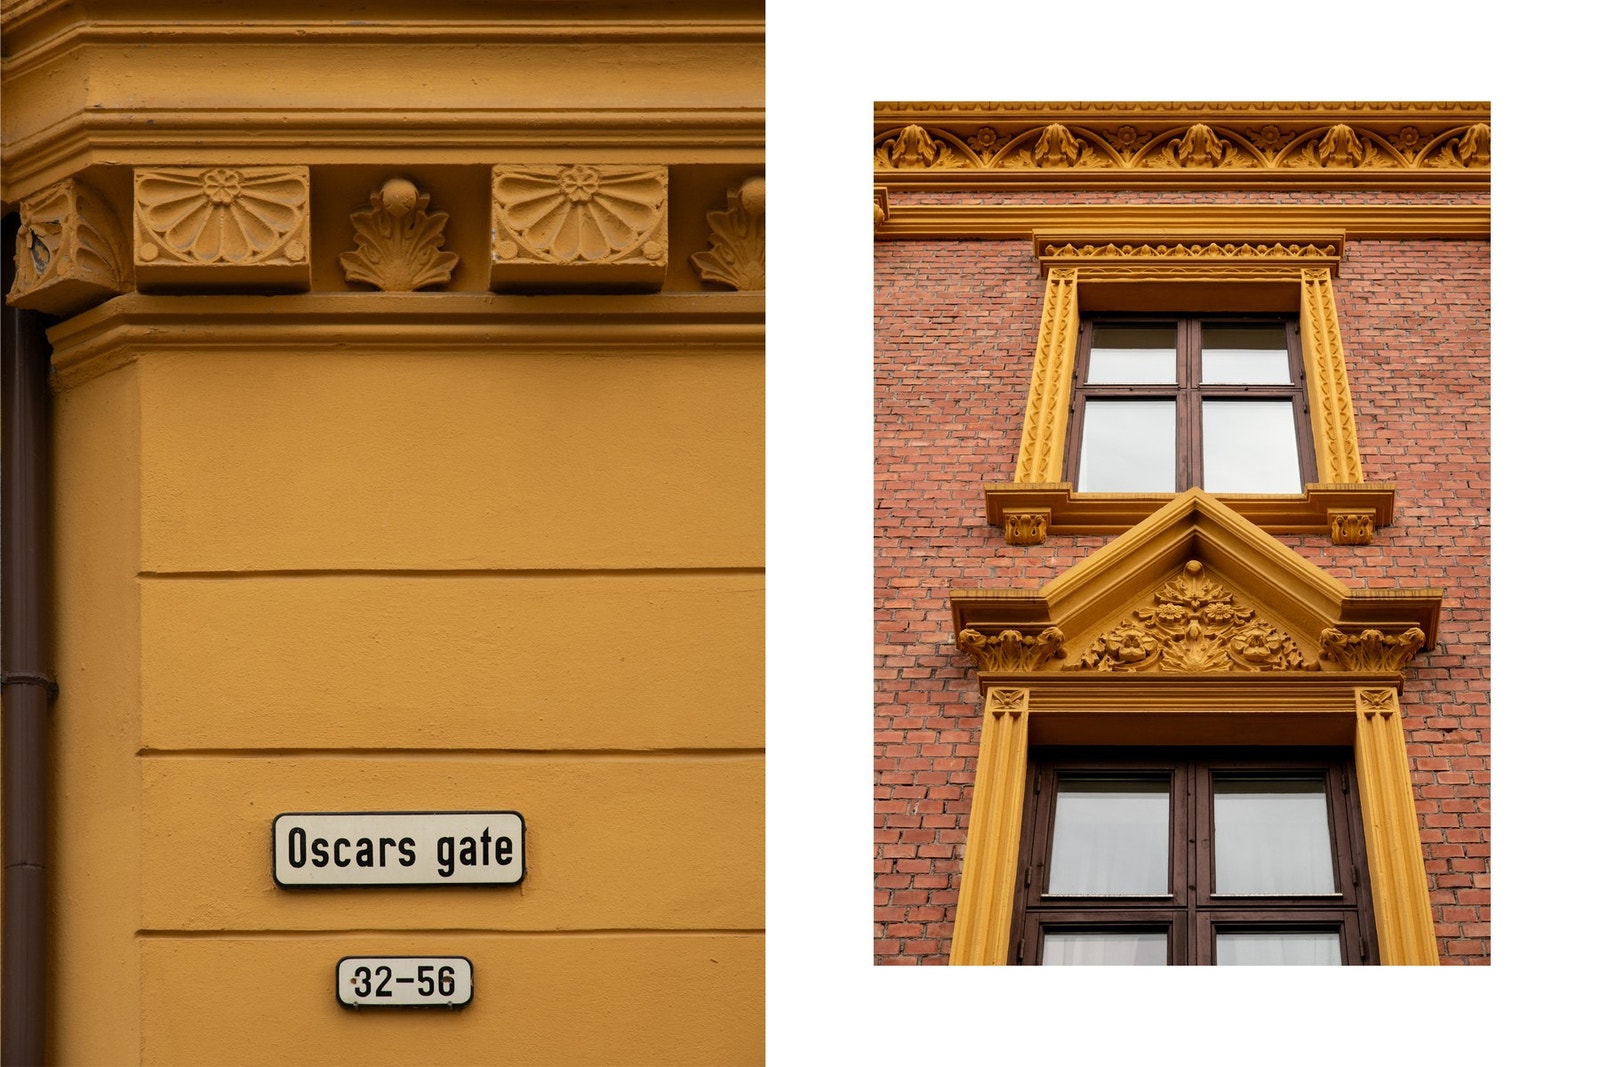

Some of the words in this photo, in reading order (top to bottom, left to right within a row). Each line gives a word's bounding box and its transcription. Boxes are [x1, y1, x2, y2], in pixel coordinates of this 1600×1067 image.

[288, 827, 416, 868] Oscars
[437, 827, 513, 877] gate
[354, 965, 455, 997] 32-56
